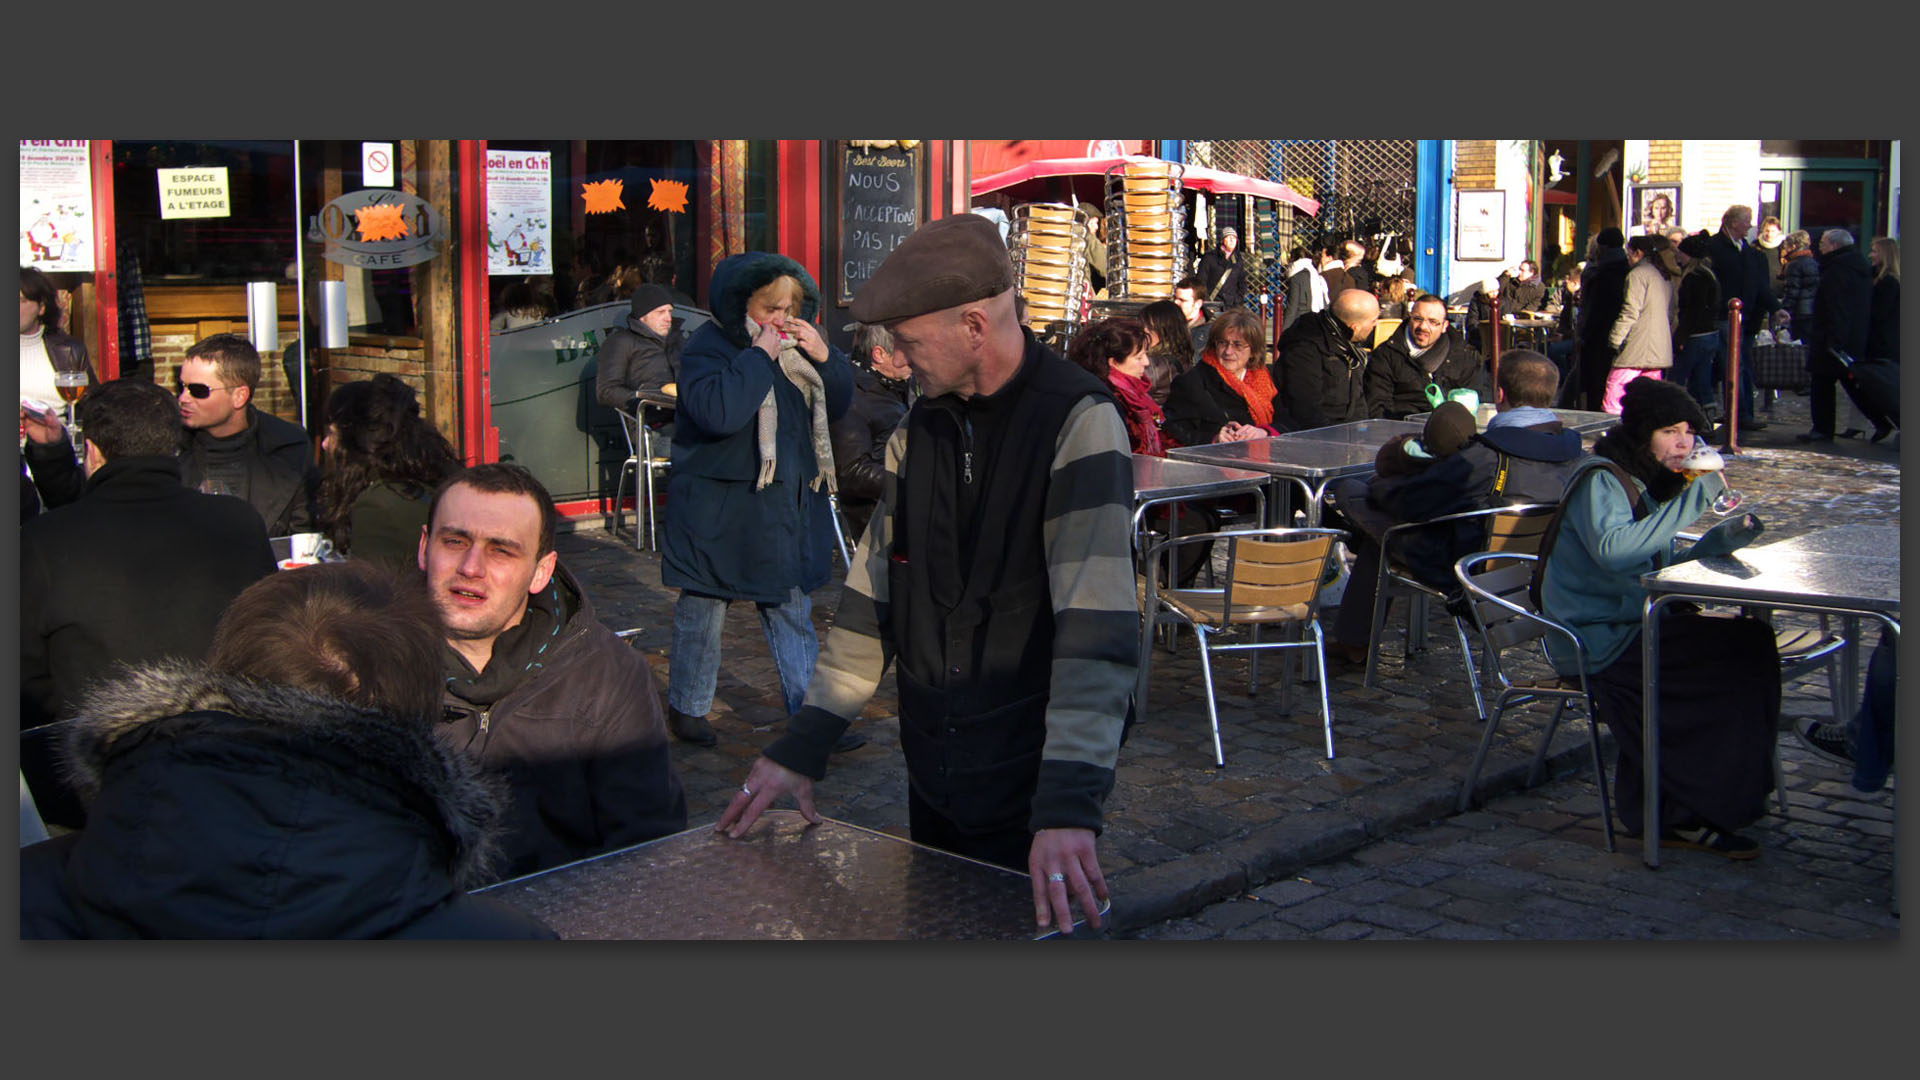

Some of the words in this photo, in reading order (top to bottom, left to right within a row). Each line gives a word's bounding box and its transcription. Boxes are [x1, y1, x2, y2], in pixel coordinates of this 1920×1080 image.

[487, 155, 506, 168] oël
[509, 160, 523, 169] en
[172, 174, 216, 183] ESPACE
[849, 172, 901, 192] NOUS
[167, 187, 223, 197] FUMEURS
[167, 202, 176, 210] A
[179, 200, 225, 210] L'ETAGE
[853, 230, 882, 250] PAS
